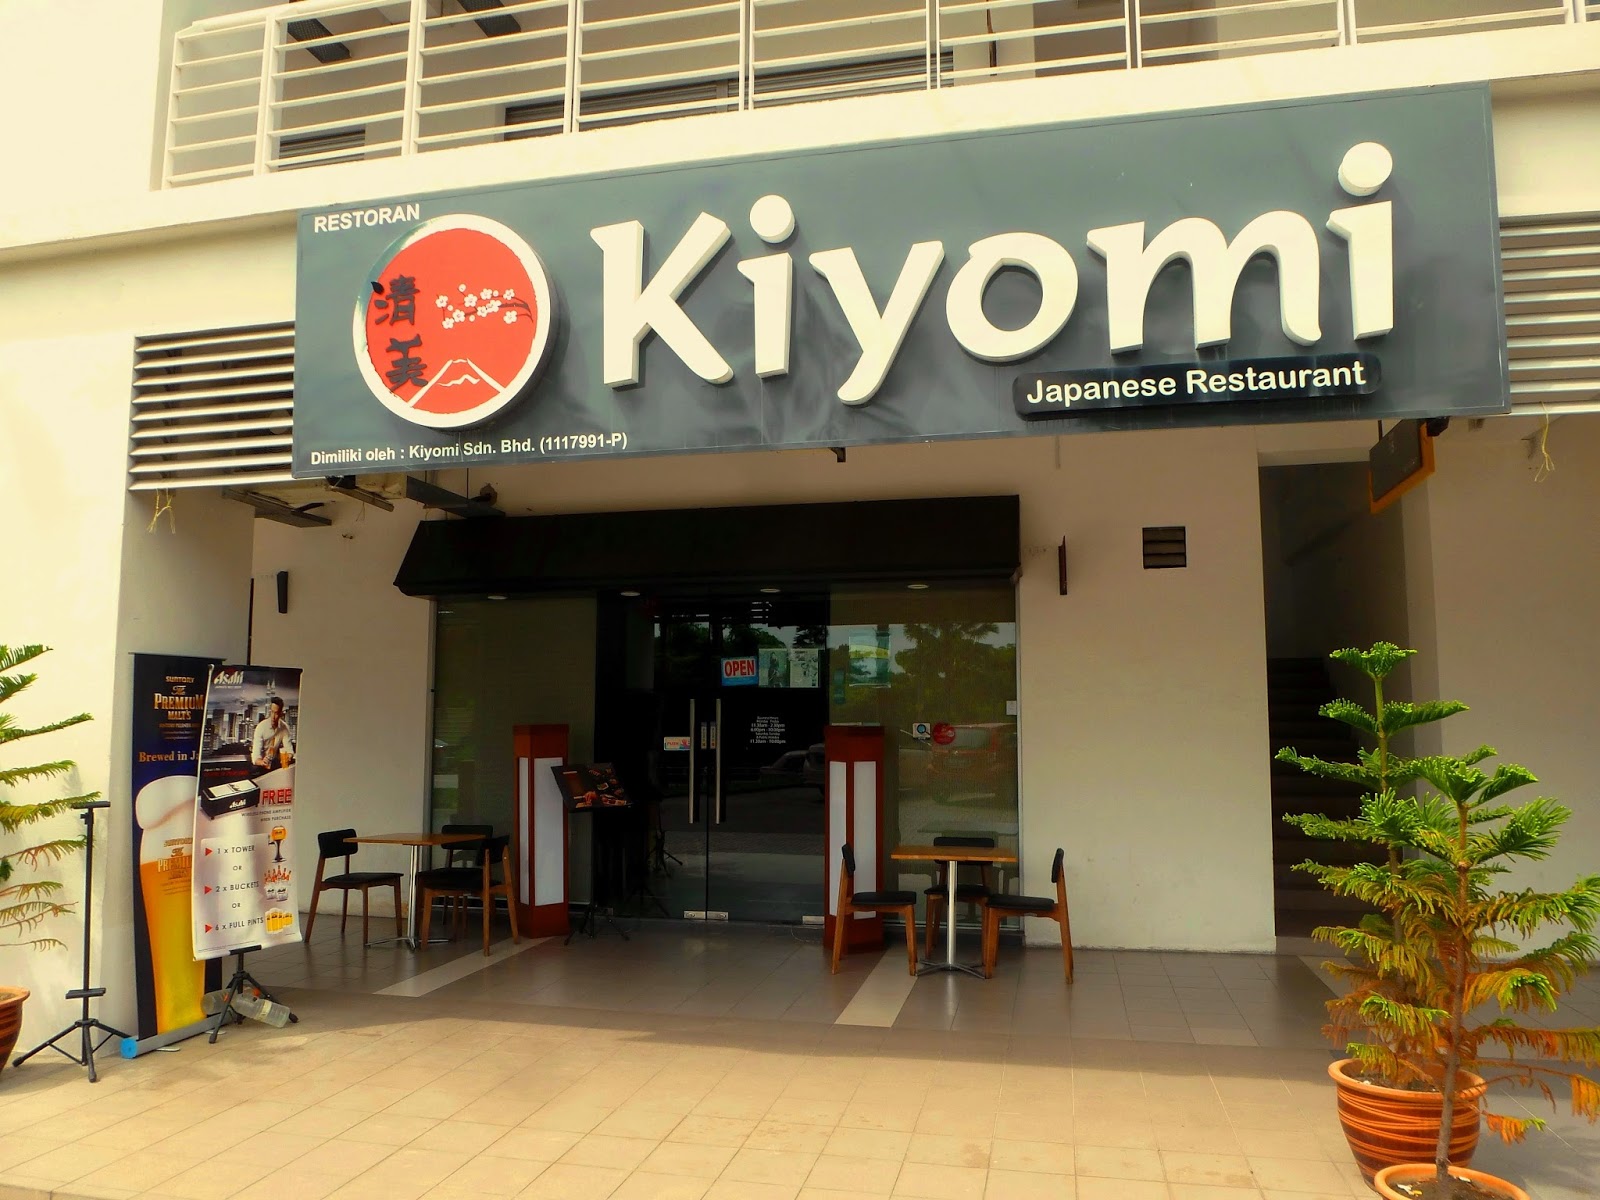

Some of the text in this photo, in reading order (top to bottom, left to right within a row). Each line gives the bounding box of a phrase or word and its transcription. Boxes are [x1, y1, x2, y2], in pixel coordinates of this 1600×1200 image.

[314, 204, 420, 233] RESTORAN
[589, 140, 1394, 406] Kiyomi
[1026, 360, 1367, 408] Japanese Restaurant
[311, 448, 362, 465] Dimiliki
[365, 448, 396, 462] oleh
[409, 444, 460, 462] Kiyomi
[463, 441, 497, 456] Sdn.
[501, 438, 535, 454] Bhd.
[540, 432, 628, 454] (1117991-P)
[724, 660, 755, 677] OPEN
[154, 693, 204, 710] PREMIUM
[139, 750, 175, 763] Brewed
[177, 750, 188, 761] in
[262, 789, 292, 805] FREE
[231, 844, 255, 853] TOWER
[229, 880, 260, 891] BUCKETS
[229, 920, 245, 929] FULL
[247, 917, 264, 926] PINTS
